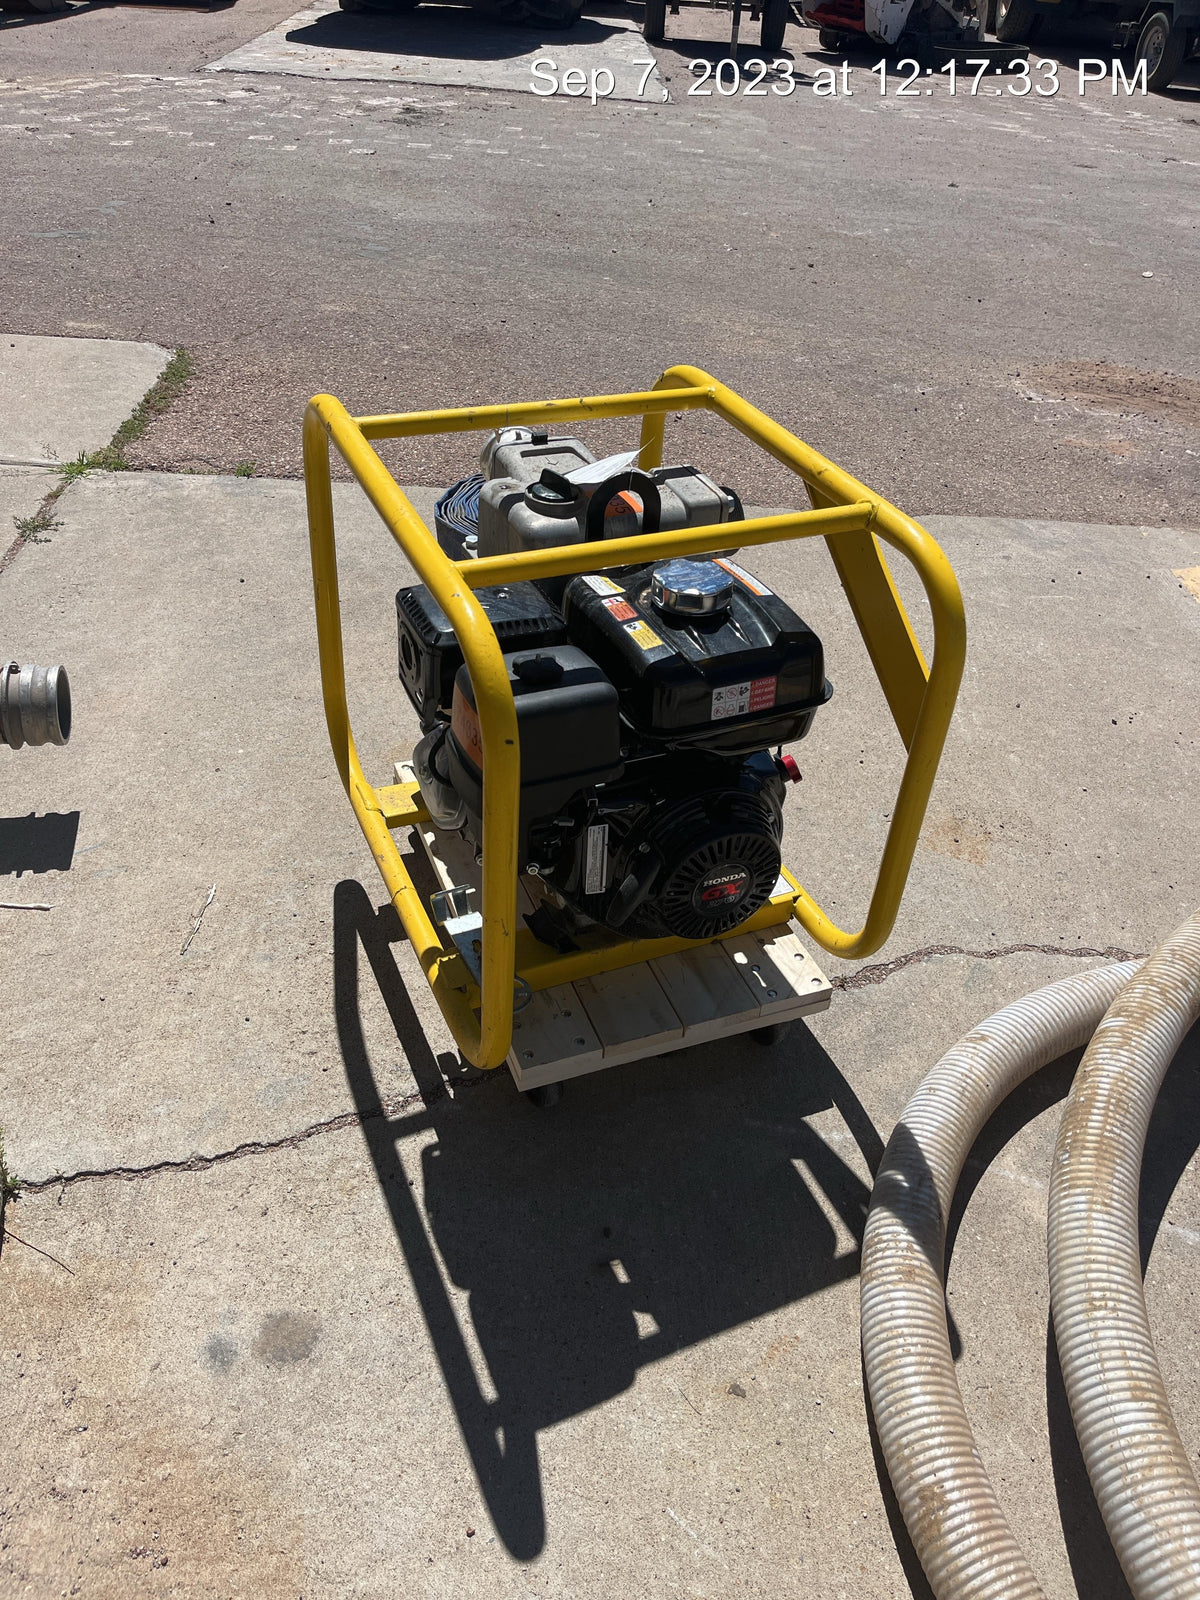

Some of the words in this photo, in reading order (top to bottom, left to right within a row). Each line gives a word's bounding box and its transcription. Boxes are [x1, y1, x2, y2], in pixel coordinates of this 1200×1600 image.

[755, 678, 776, 687] DANGER
[703, 872, 747, 887] HONDA
[702, 880, 744, 901] GX
